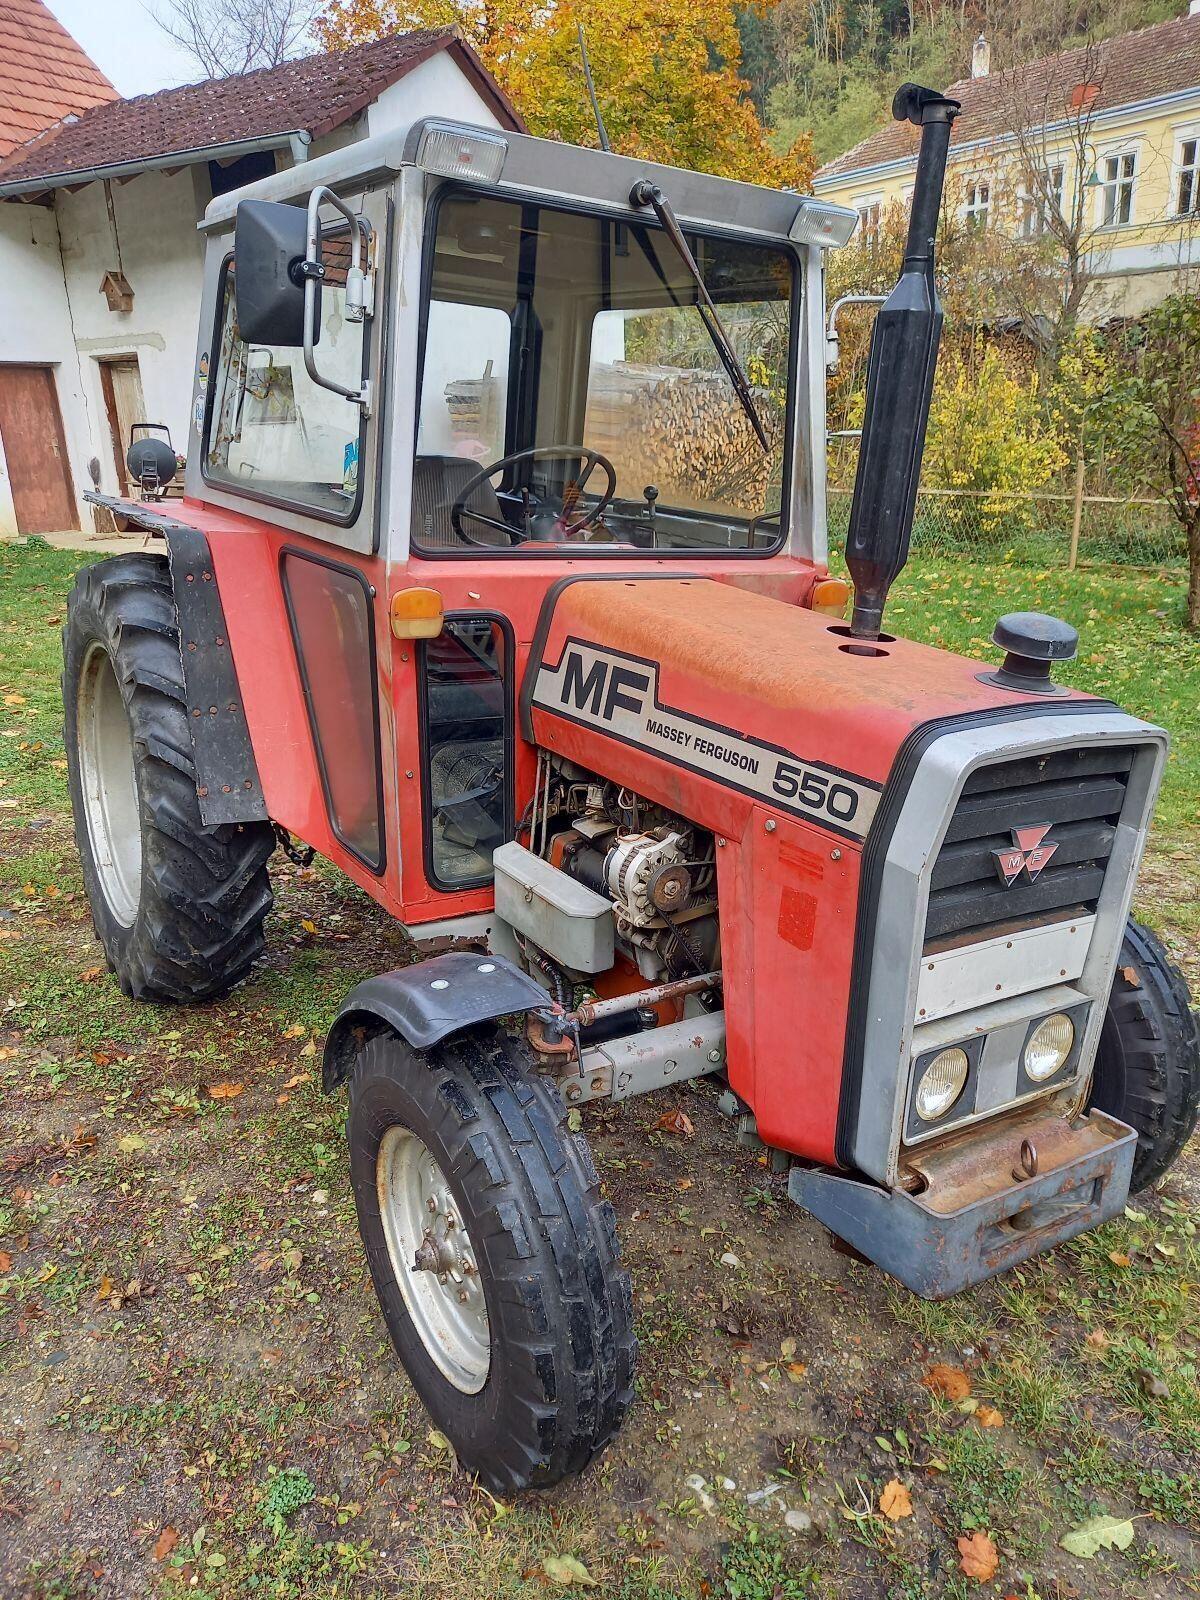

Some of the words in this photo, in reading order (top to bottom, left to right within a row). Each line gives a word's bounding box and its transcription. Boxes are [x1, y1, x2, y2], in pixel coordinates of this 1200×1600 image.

[560, 652, 650, 721] MF
[646, 719, 692, 747] MASSEY
[694, 737, 759, 775] FERGUSON
[772, 761, 859, 822] 550
